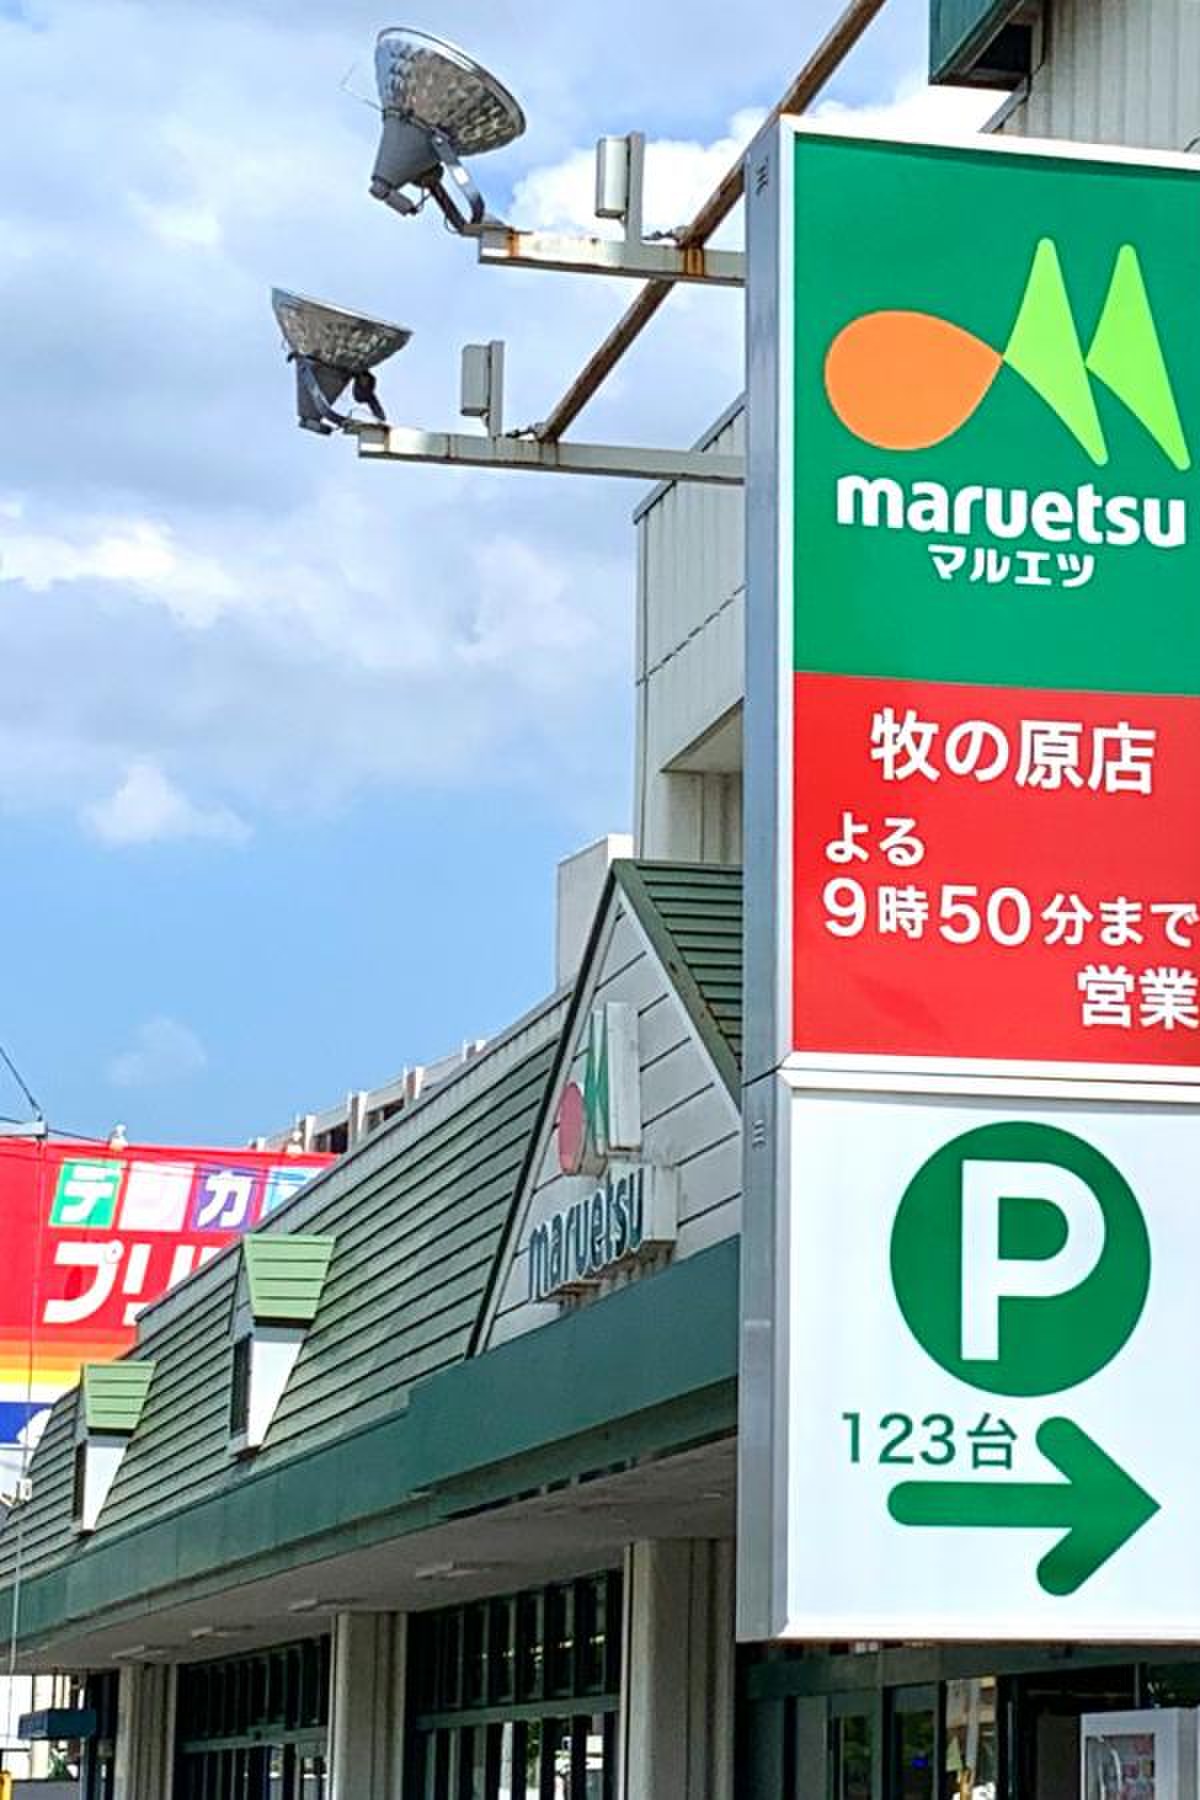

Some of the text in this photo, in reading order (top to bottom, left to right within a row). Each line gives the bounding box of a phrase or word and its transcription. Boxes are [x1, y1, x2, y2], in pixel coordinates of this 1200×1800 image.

[836, 474, 1187, 548] maruetsu
[927, 542, 1097, 589] マルエツ
[869, 706, 1158, 796] 牧の原店
[824, 812, 926, 868] よる
[822, 876, 1200, 949] 9時50分まで
[1076, 963, 1200, 1031] 営業
[529, 1167, 644, 1301] maruetsu
[960, 1158, 1107, 1362] P
[841, 1411, 1018, 1473] 123台
